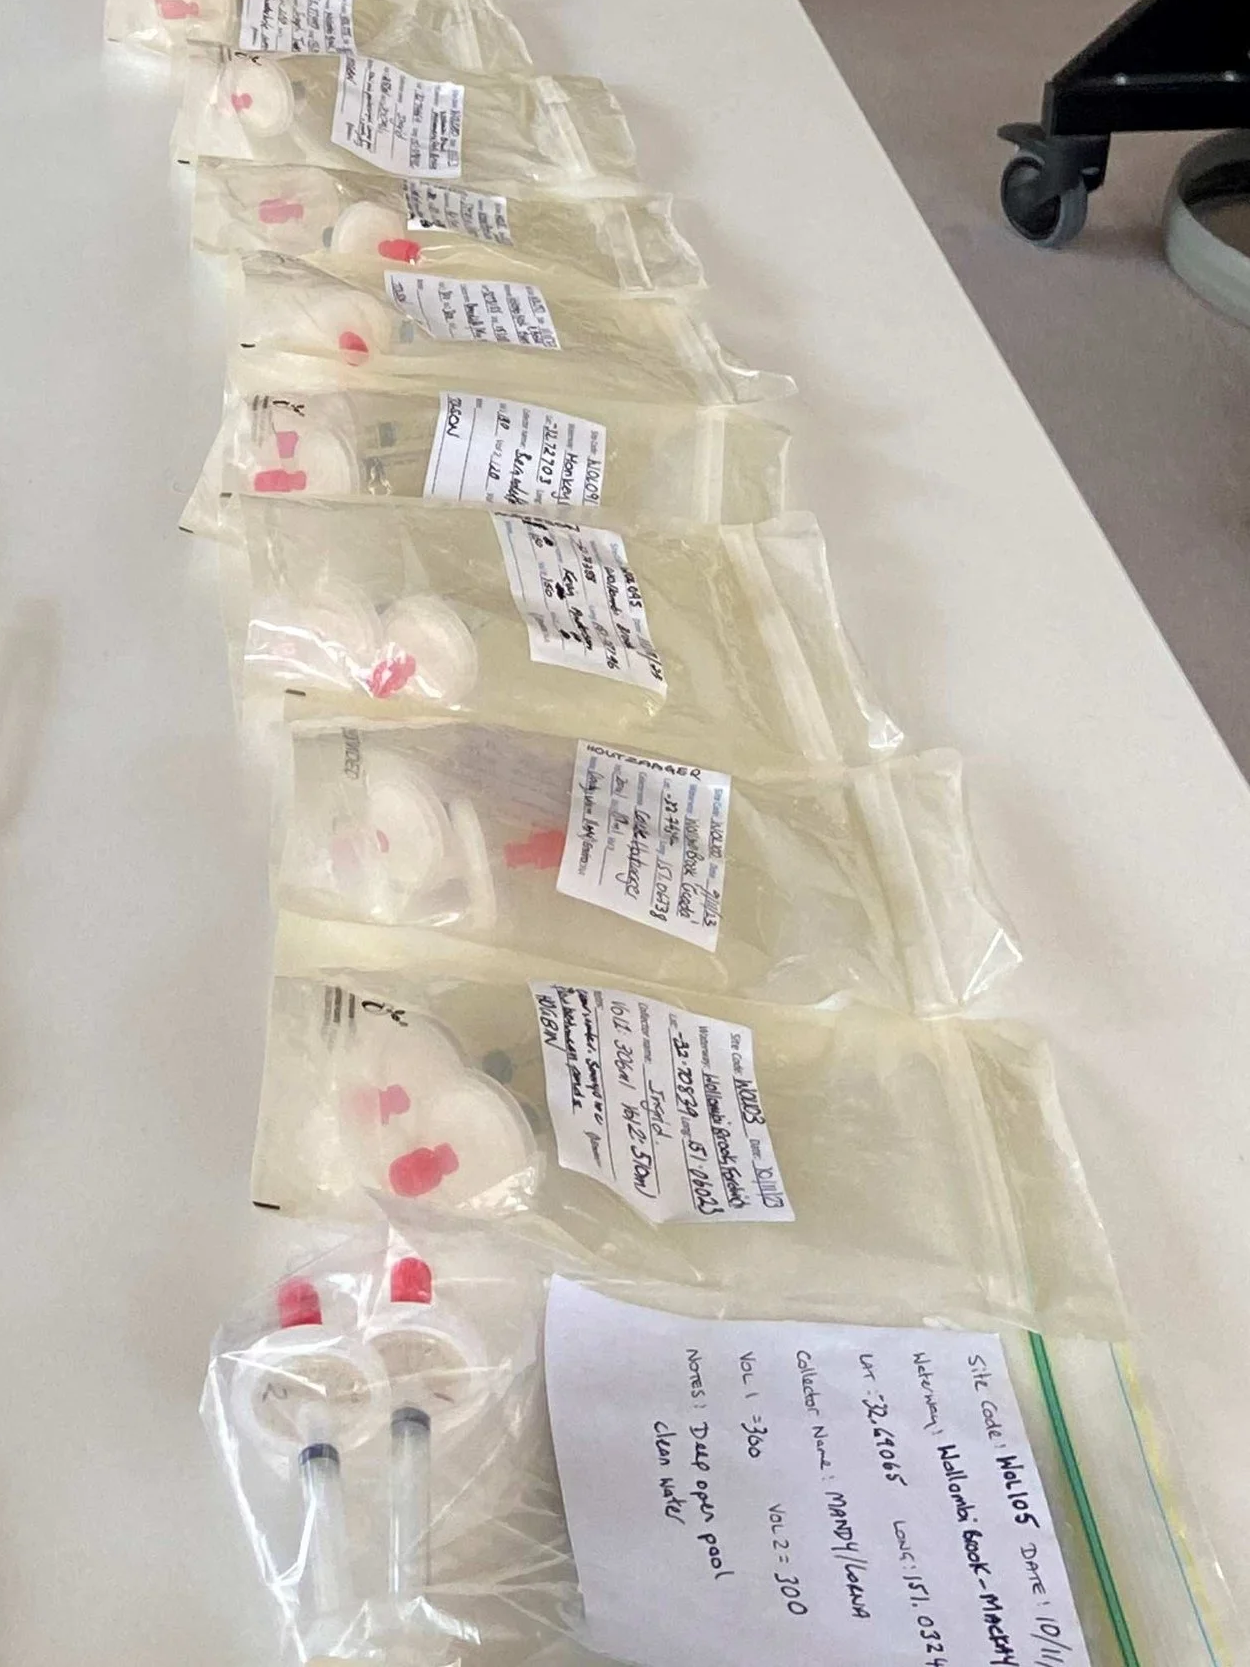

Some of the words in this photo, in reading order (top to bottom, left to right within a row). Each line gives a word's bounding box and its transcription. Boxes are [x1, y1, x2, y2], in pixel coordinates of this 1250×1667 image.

[730, 1033, 741, 1052] Site
[740, 1351, 756, 1386] VOL
[796, 1350, 821, 1419] Collector
[967, 1354, 987, 1392] Site
[696, 1479, 716, 1523] open
[938, 1444, 969, 1523] Wollombi
[768, 1503, 788, 1535] VOL
[697, 1532, 735, 1581] pool
[771, 1540, 789, 1552] 2
[773, 1572, 810, 1616] 300
